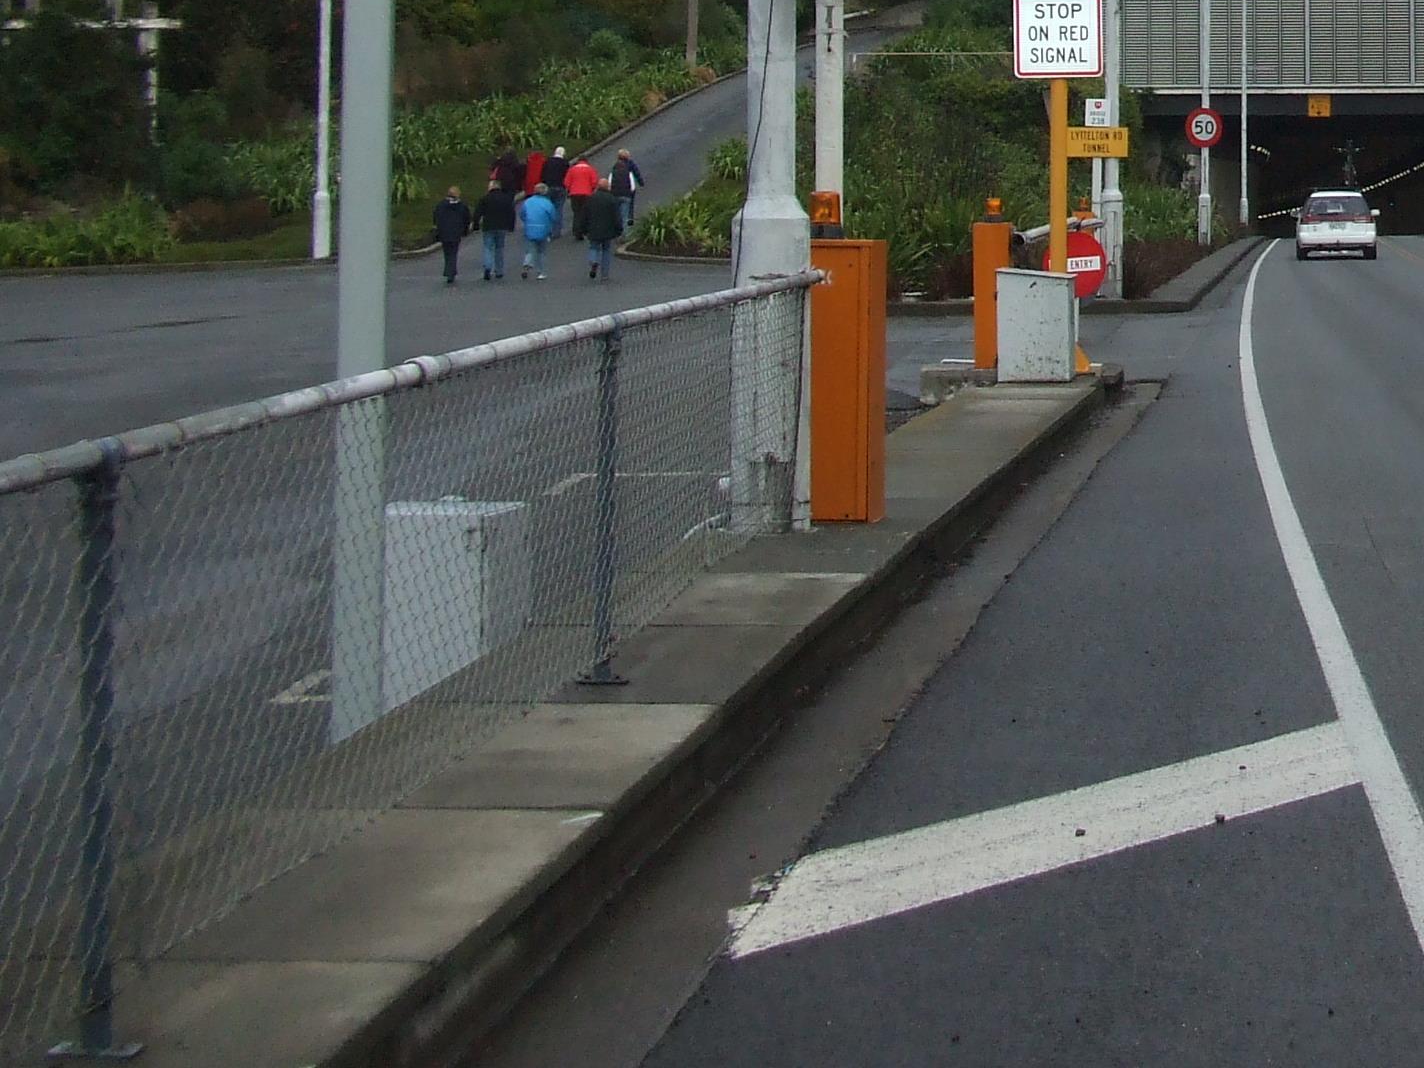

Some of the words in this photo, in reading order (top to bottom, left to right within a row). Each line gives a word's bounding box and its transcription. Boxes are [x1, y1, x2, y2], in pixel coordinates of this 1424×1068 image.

[1034, 3, 1082, 19] STOP
[1028, 25, 1049, 42] ON
[1059, 25, 1089, 42] RED
[1030, 47, 1088, 63] SIGNAL
[1194, 120, 1214, 135] 50
[1070, 131, 1110, 141] LYTTELTON
[1083, 143, 1111, 153] TUNNEL
[1070, 259, 1093, 270] ENTRY
